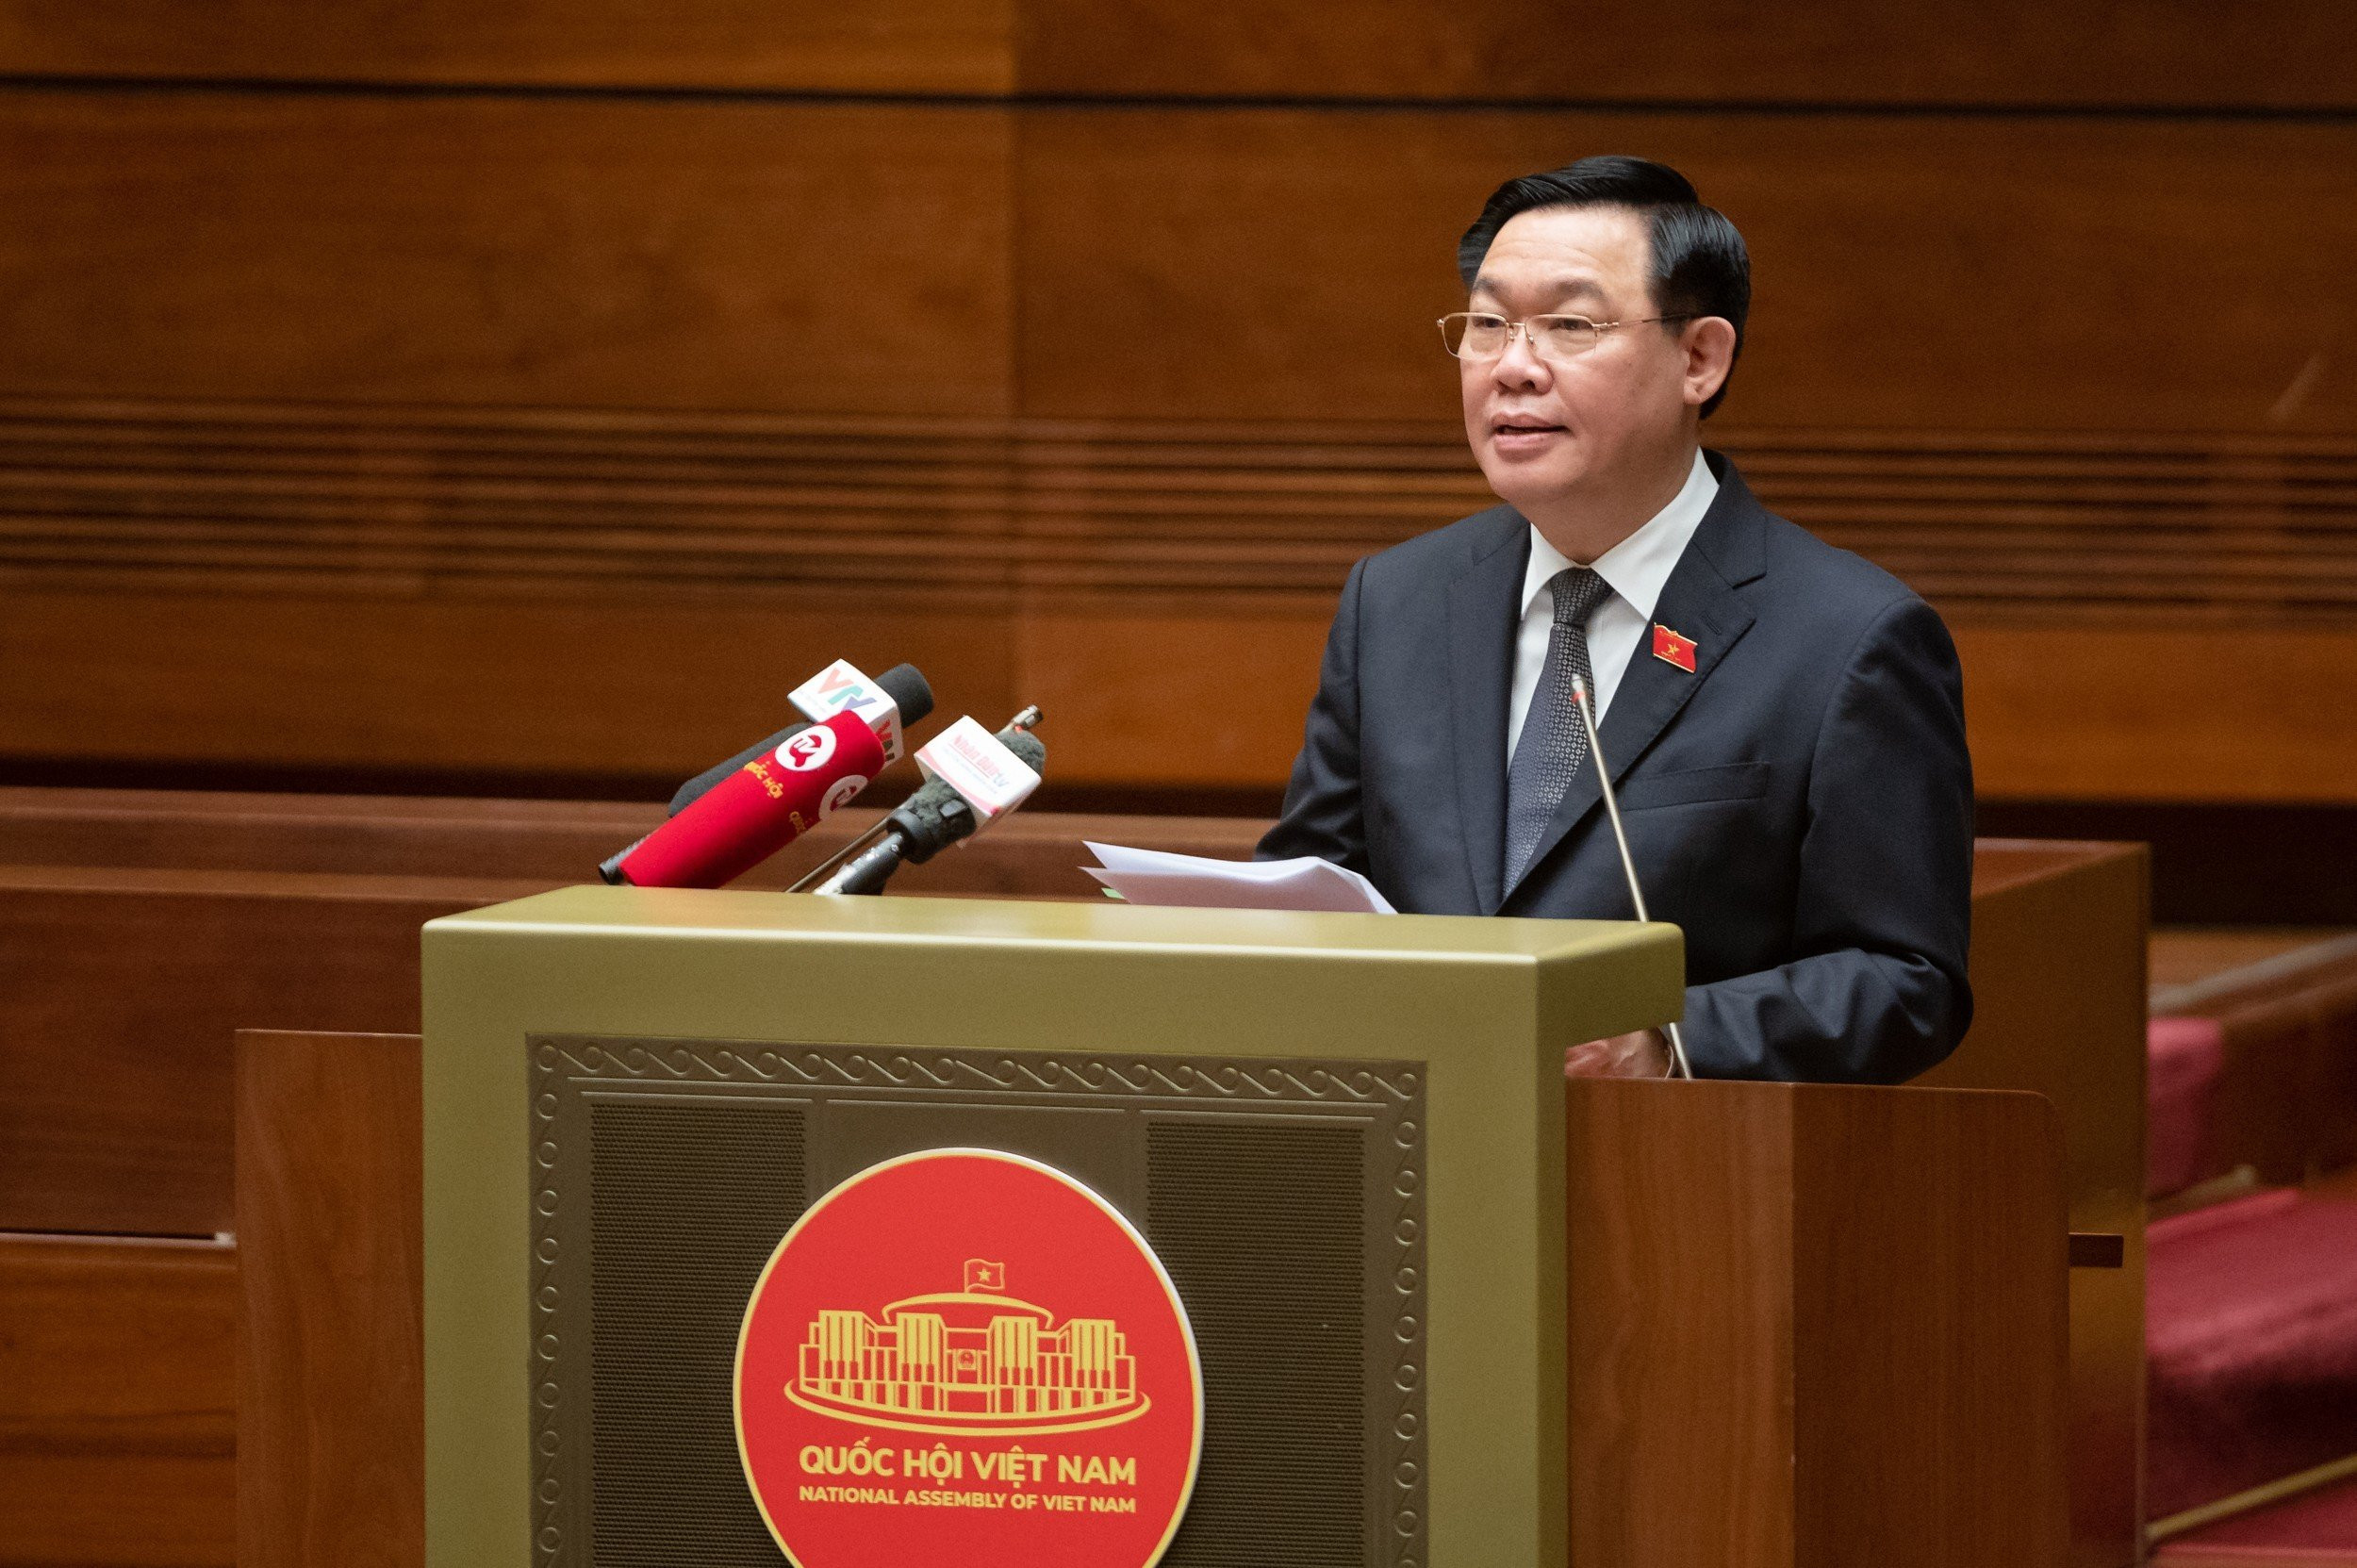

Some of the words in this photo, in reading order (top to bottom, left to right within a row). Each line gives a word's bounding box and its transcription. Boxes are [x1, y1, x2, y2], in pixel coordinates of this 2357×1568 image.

[799, 1436, 895, 1477] QUỐC
[903, 1442, 964, 1487] HỘI
[970, 1444, 1049, 1489] VIỆT
[1057, 1454, 1137, 1486] NAM
[799, 1485, 900, 1505] NATIONAL
[903, 1489, 1007, 1509] ASSEMBLY
[1010, 1493, 1038, 1510] OF
[1042, 1494, 1087, 1511] VIET
[1090, 1495, 1136, 1513] NAM
